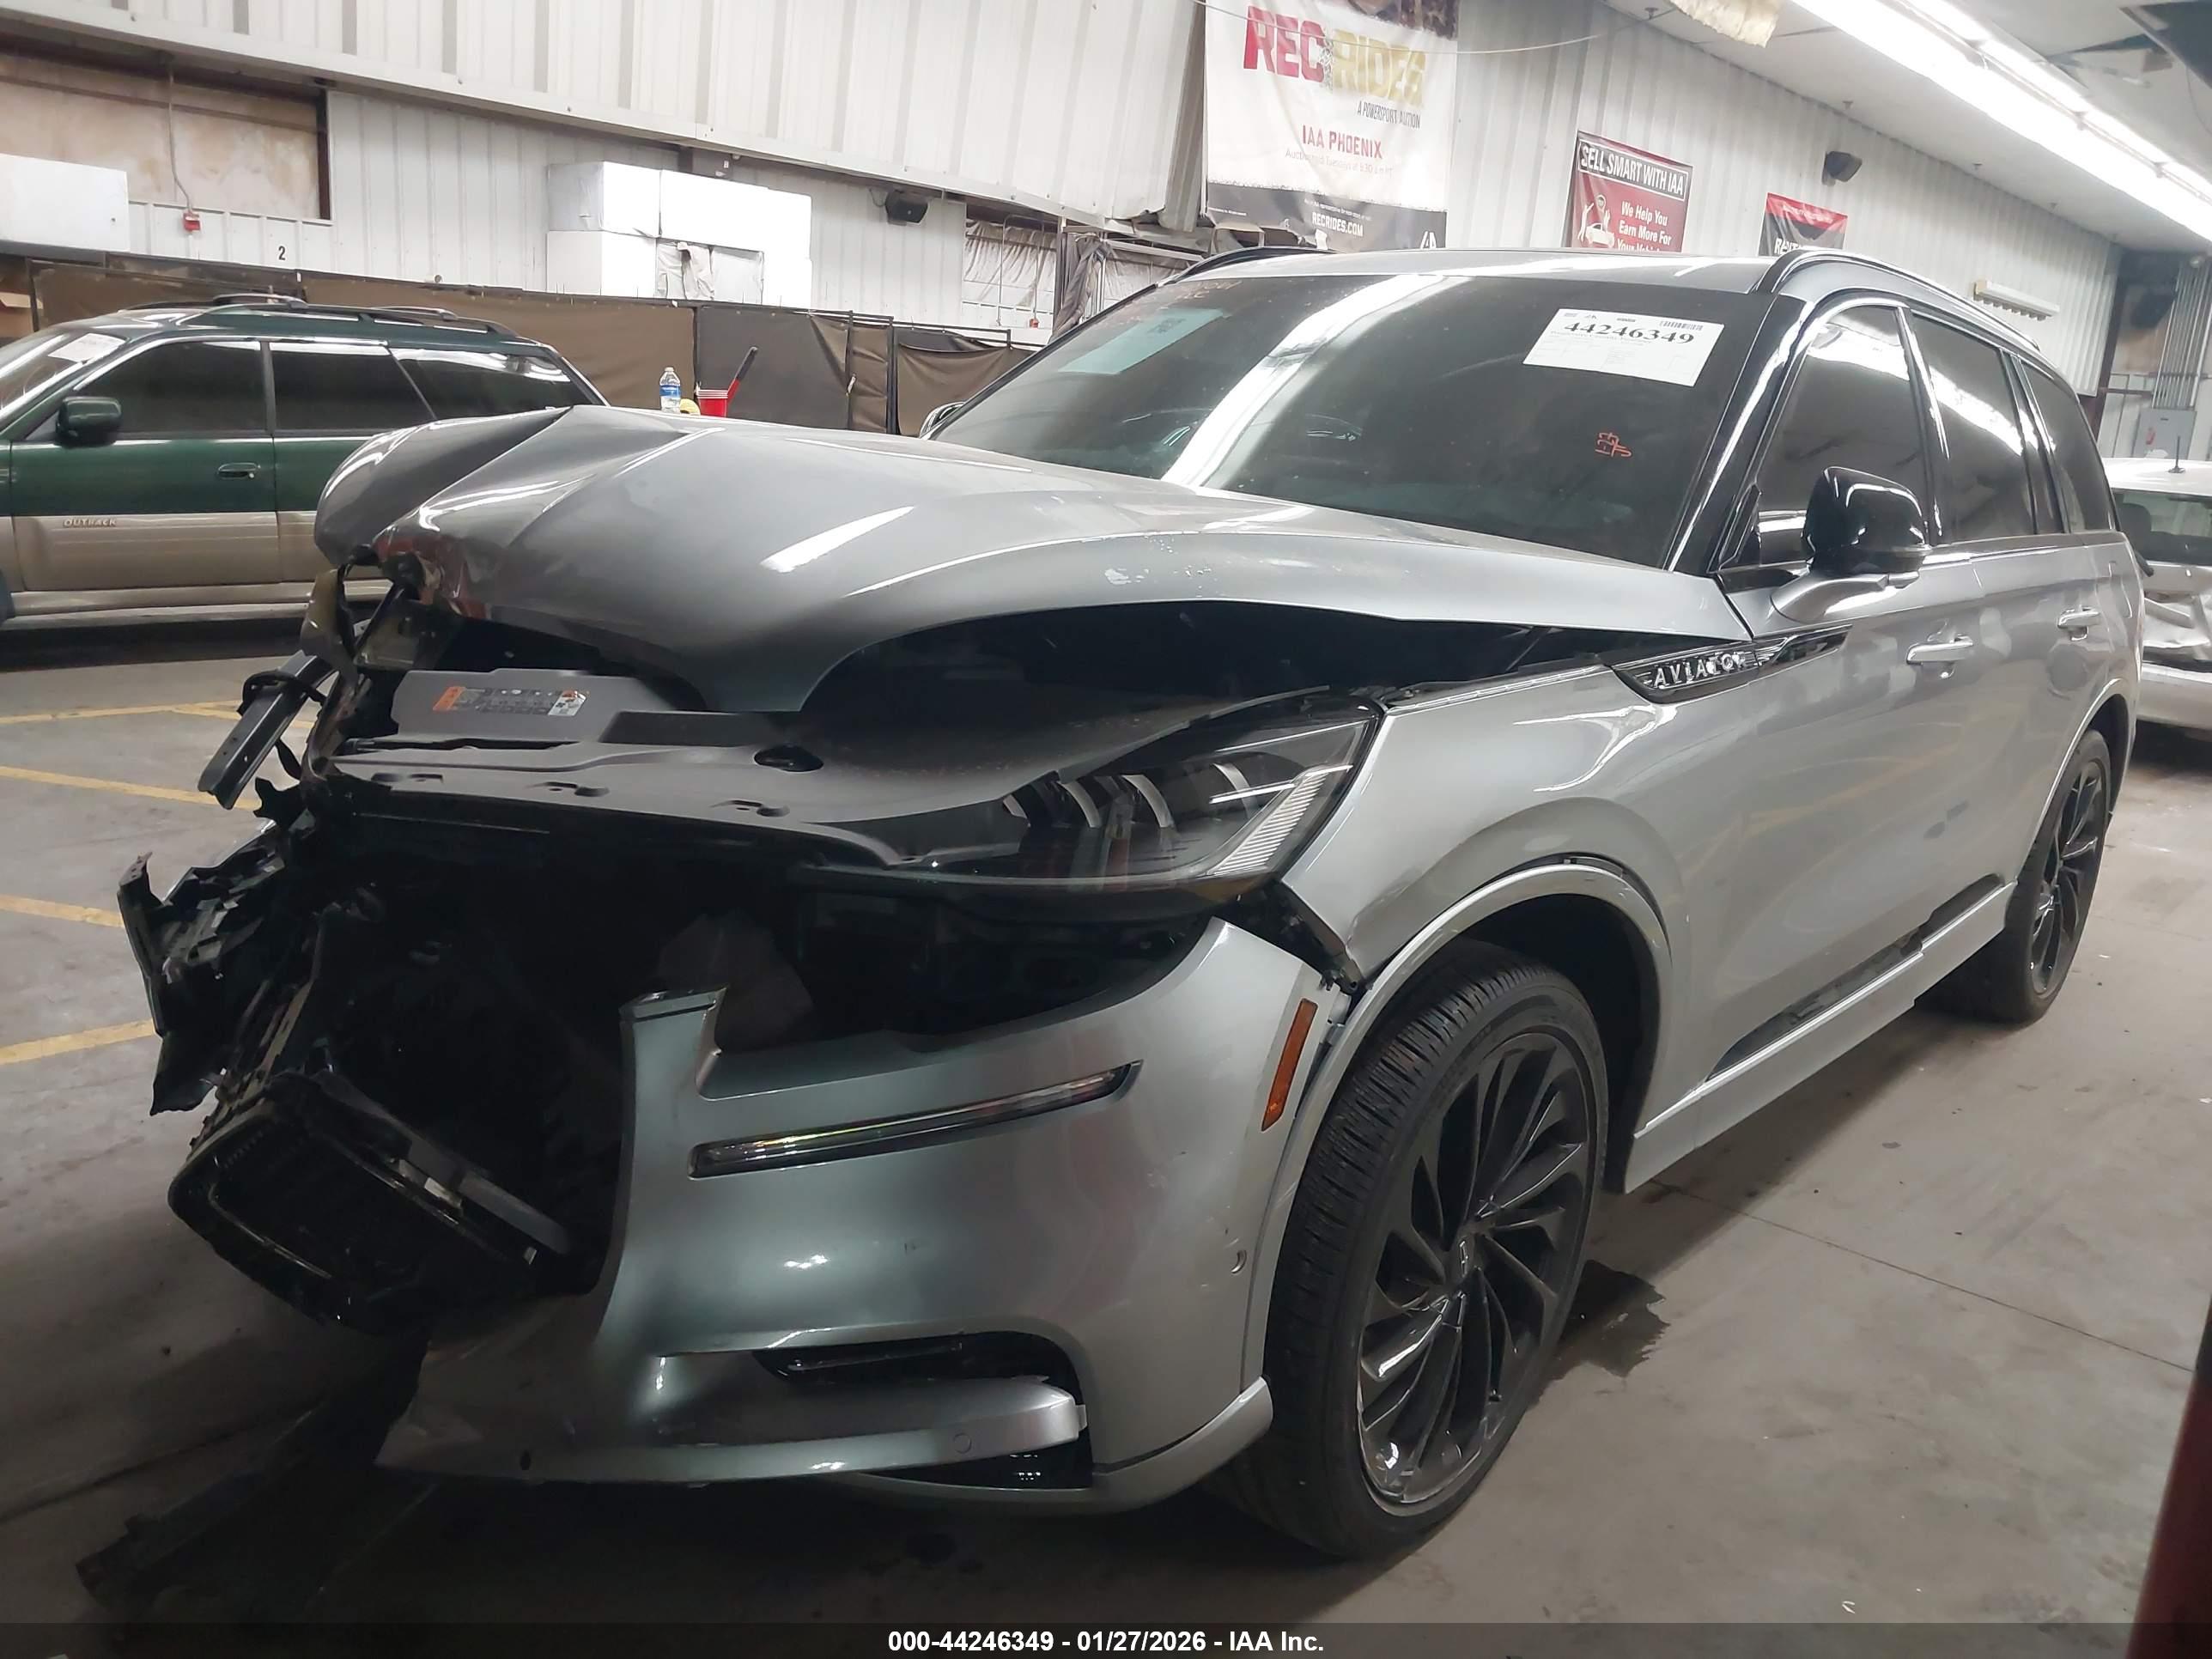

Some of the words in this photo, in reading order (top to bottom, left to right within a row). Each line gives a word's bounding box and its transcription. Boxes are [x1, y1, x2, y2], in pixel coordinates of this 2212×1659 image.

[1363, 101, 1397, 125] POWERSPORT
[1303, 125, 1324, 148] IAA
[1328, 131, 1382, 159] PHOENIX
[1581, 144, 1605, 172] SELL
[1607, 153, 1643, 183] SMART
[1643, 164, 1666, 190] WITH
[1668, 171, 1683, 196] IAA
[1312, 211, 1364, 237] RECRIDES.COM
[1621, 200, 1633, 217] We
[1635, 204, 1653, 225] Help
[1655, 210, 1668, 227] You
[1619, 220, 1636, 237] Earn
[1638, 224, 1657, 241] More
[1658, 230, 1672, 246] For
[278, 246, 286, 260] 2
[1564, 321, 1695, 344] 44246349
